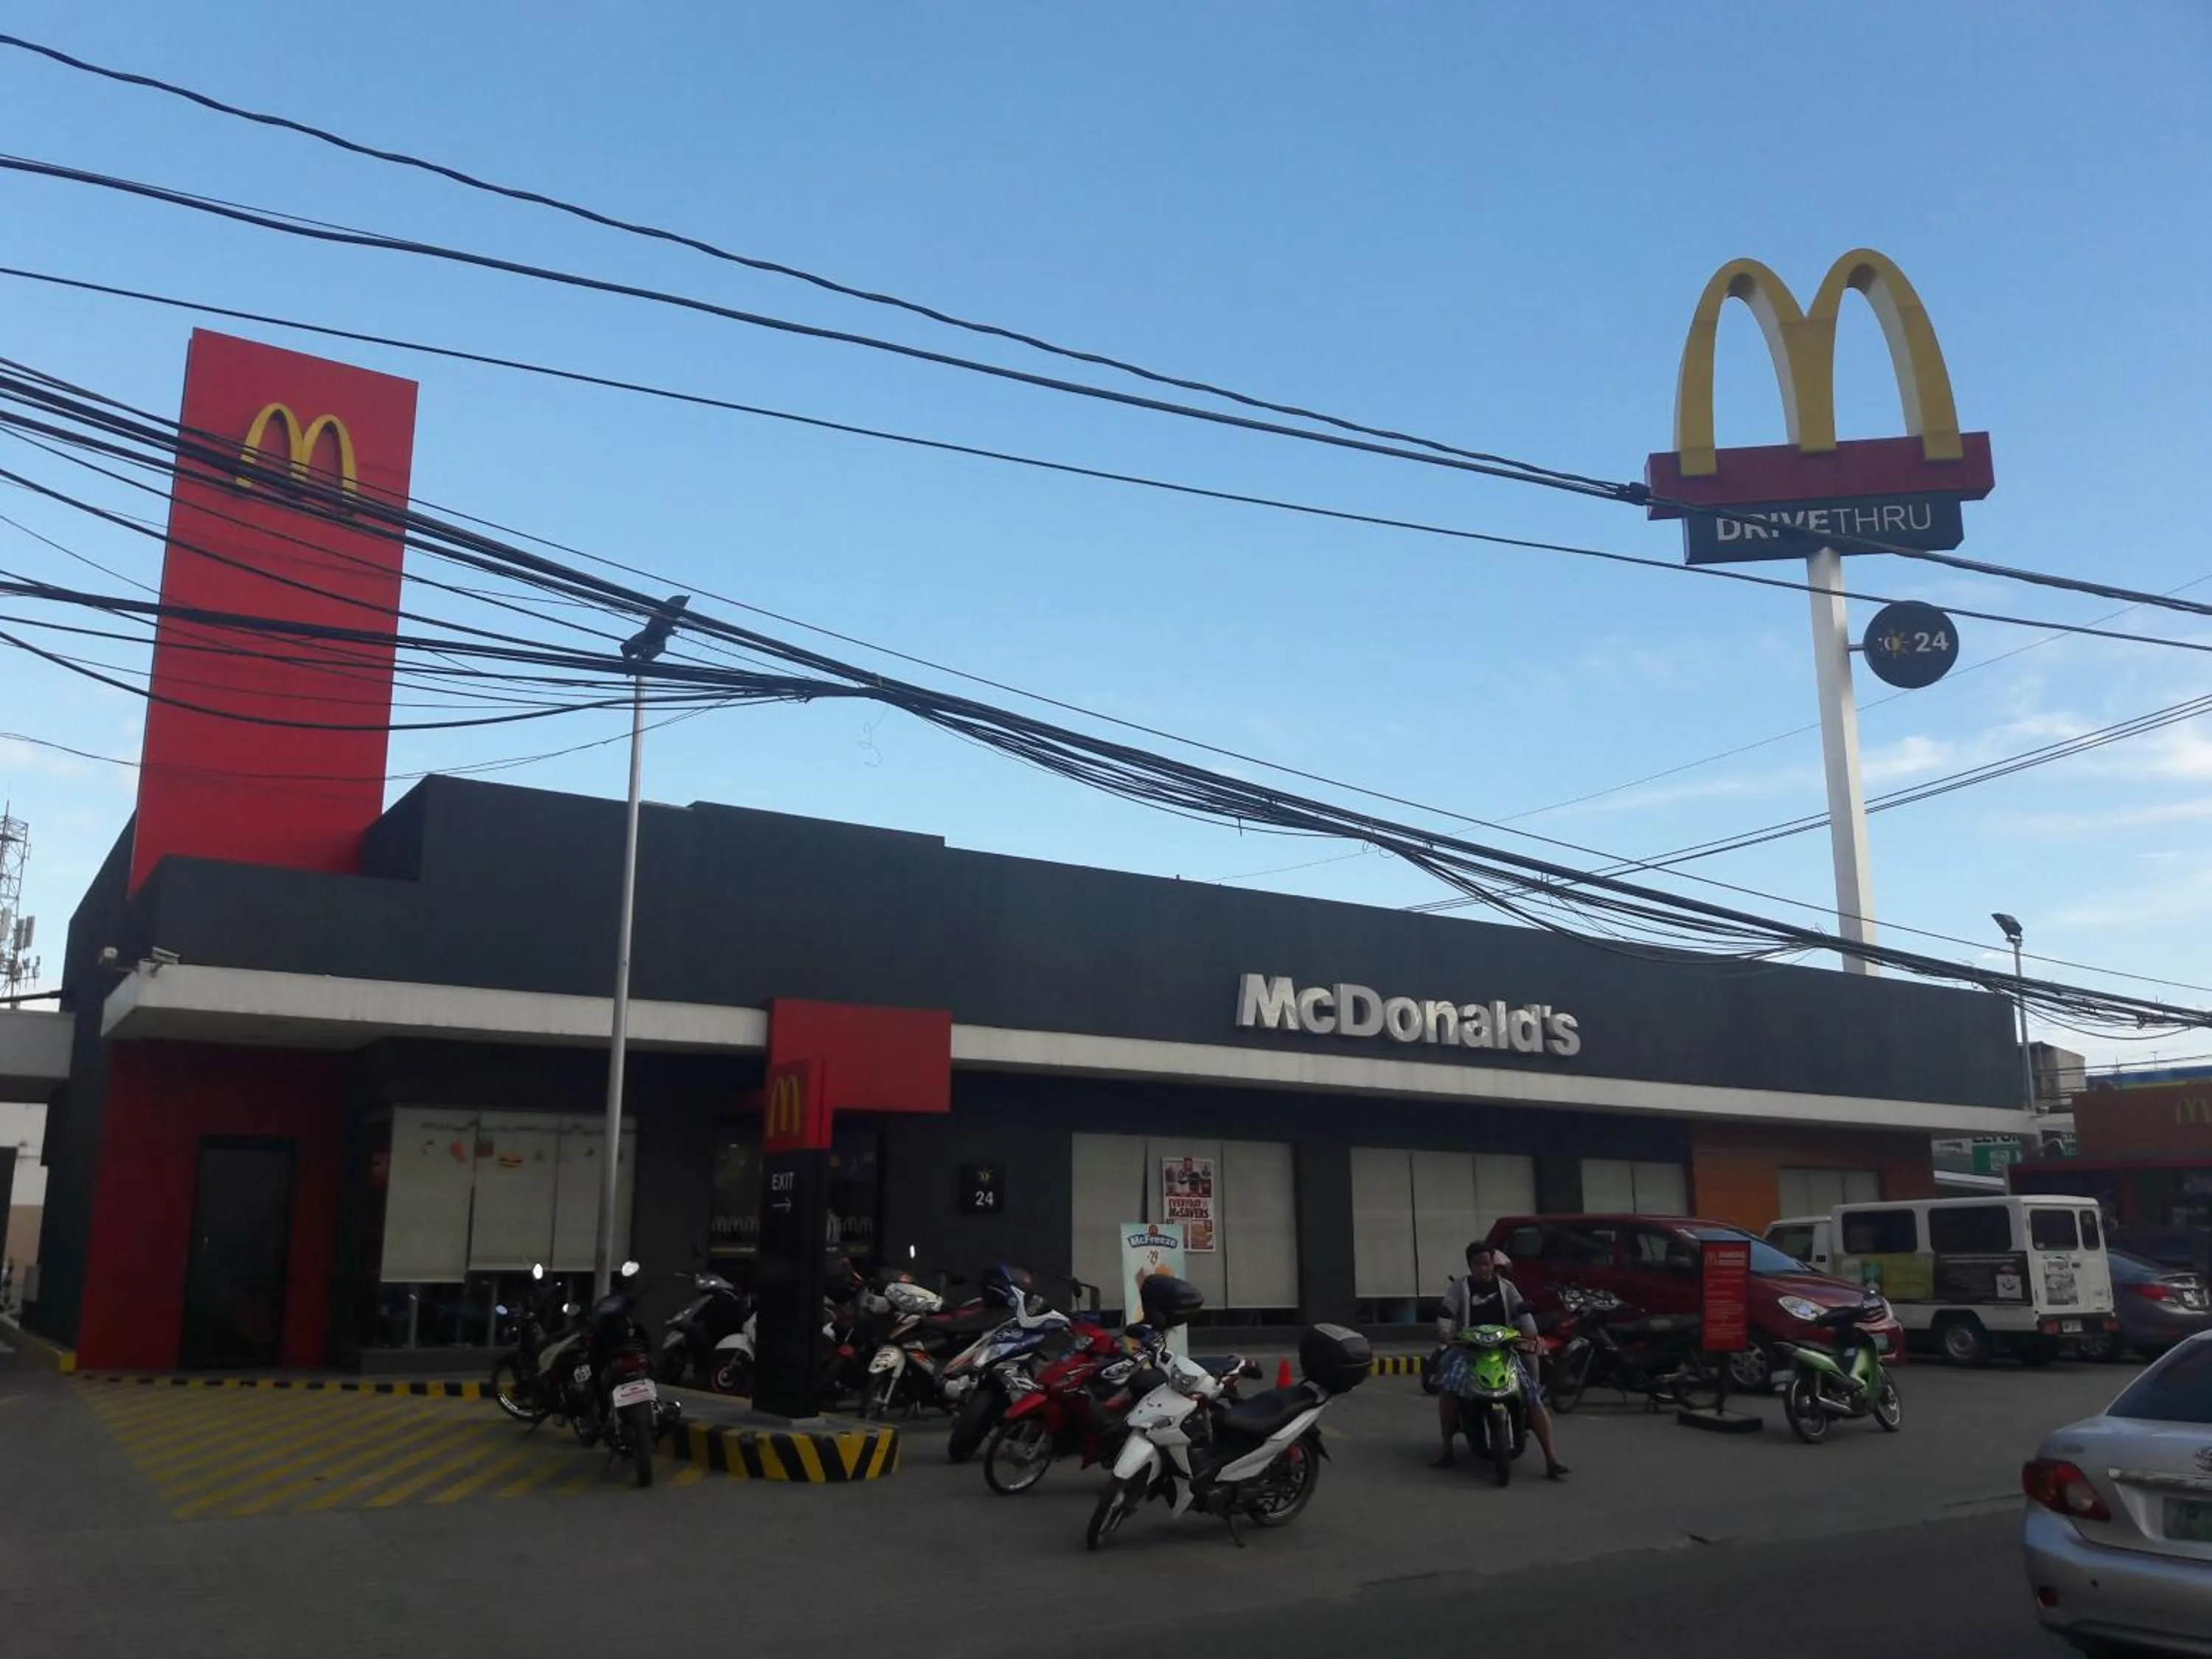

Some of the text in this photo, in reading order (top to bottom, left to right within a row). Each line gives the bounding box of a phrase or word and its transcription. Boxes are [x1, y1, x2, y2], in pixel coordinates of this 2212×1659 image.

[1913, 630, 1950, 653] 24
[1236, 973, 1582, 1056] McDonald's
[772, 1171, 796, 1192] EXIT
[974, 1190, 995, 1207] 24
